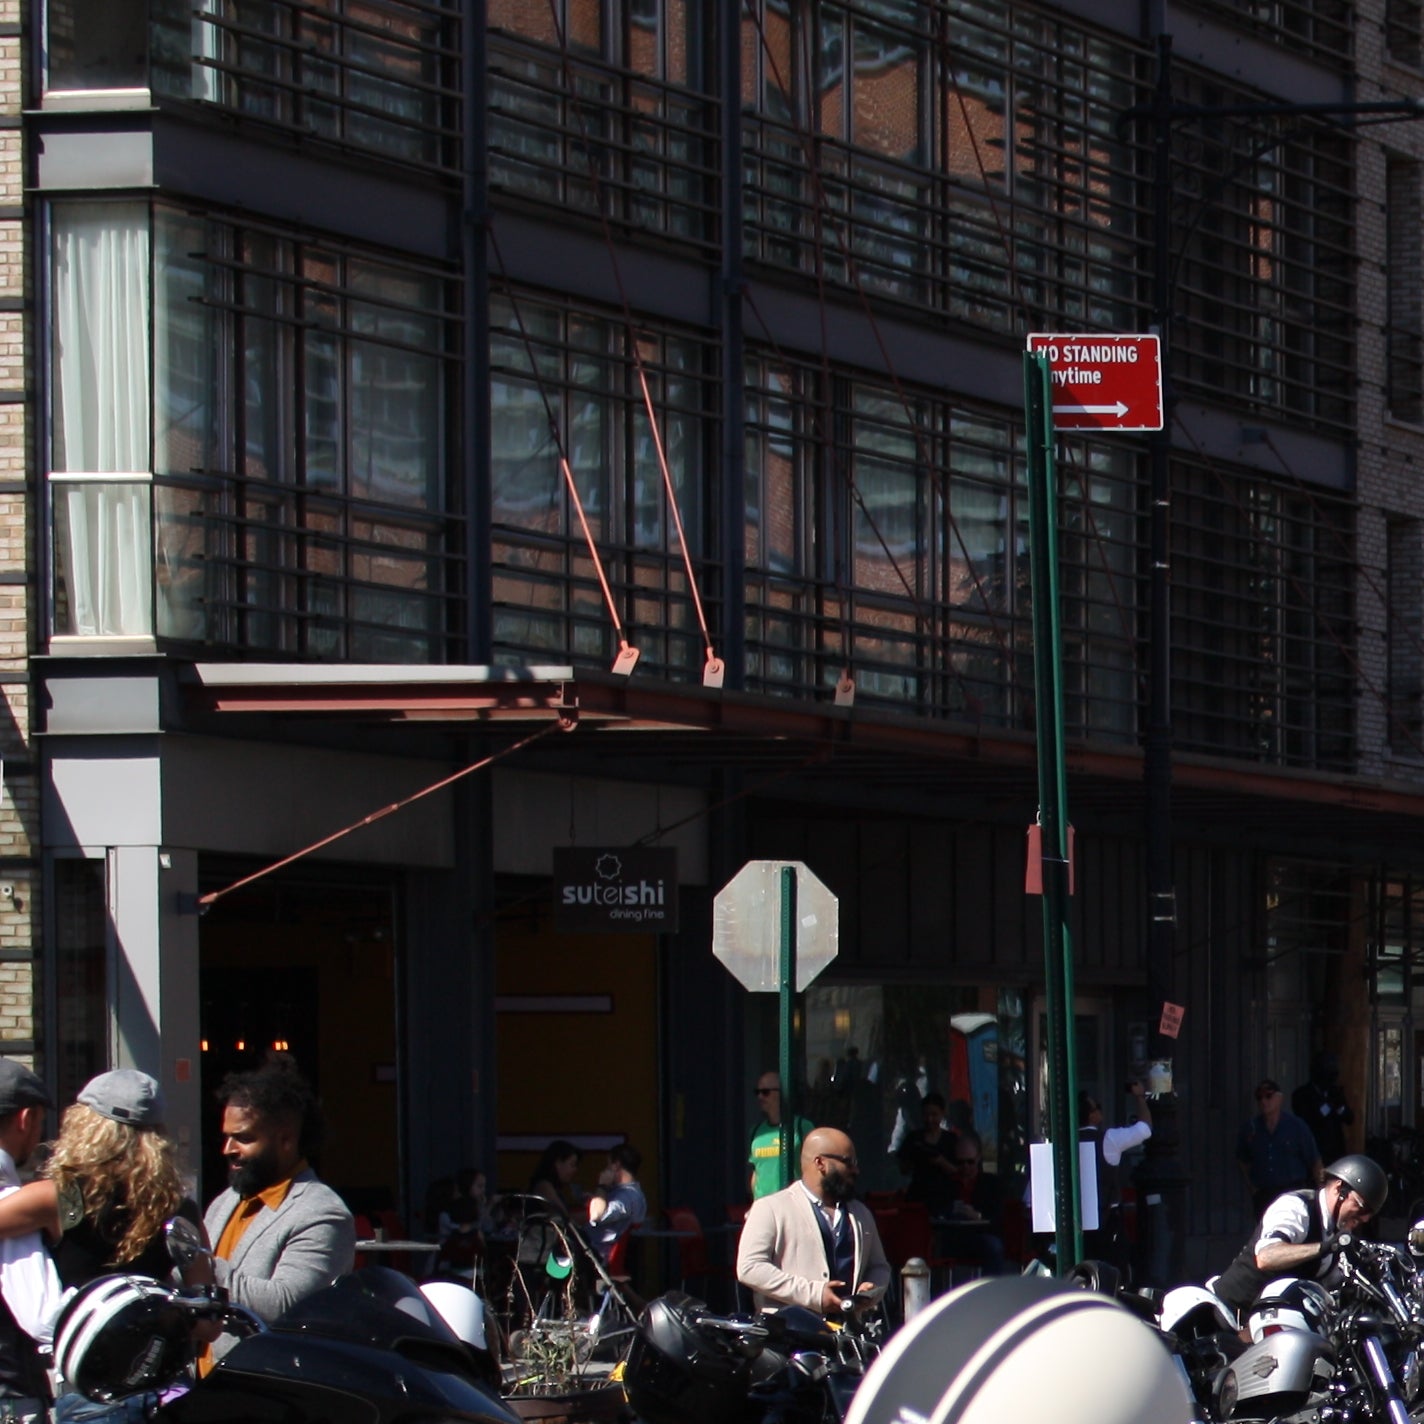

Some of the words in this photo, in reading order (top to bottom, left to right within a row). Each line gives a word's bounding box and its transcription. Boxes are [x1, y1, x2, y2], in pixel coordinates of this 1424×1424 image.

[1063, 345, 1138, 363] STANDING
[1051, 366, 1102, 387] nytime
[562, 880, 664, 905] suteishi
[609, 909, 642, 921] dining
[643, 909, 665, 919] fine
